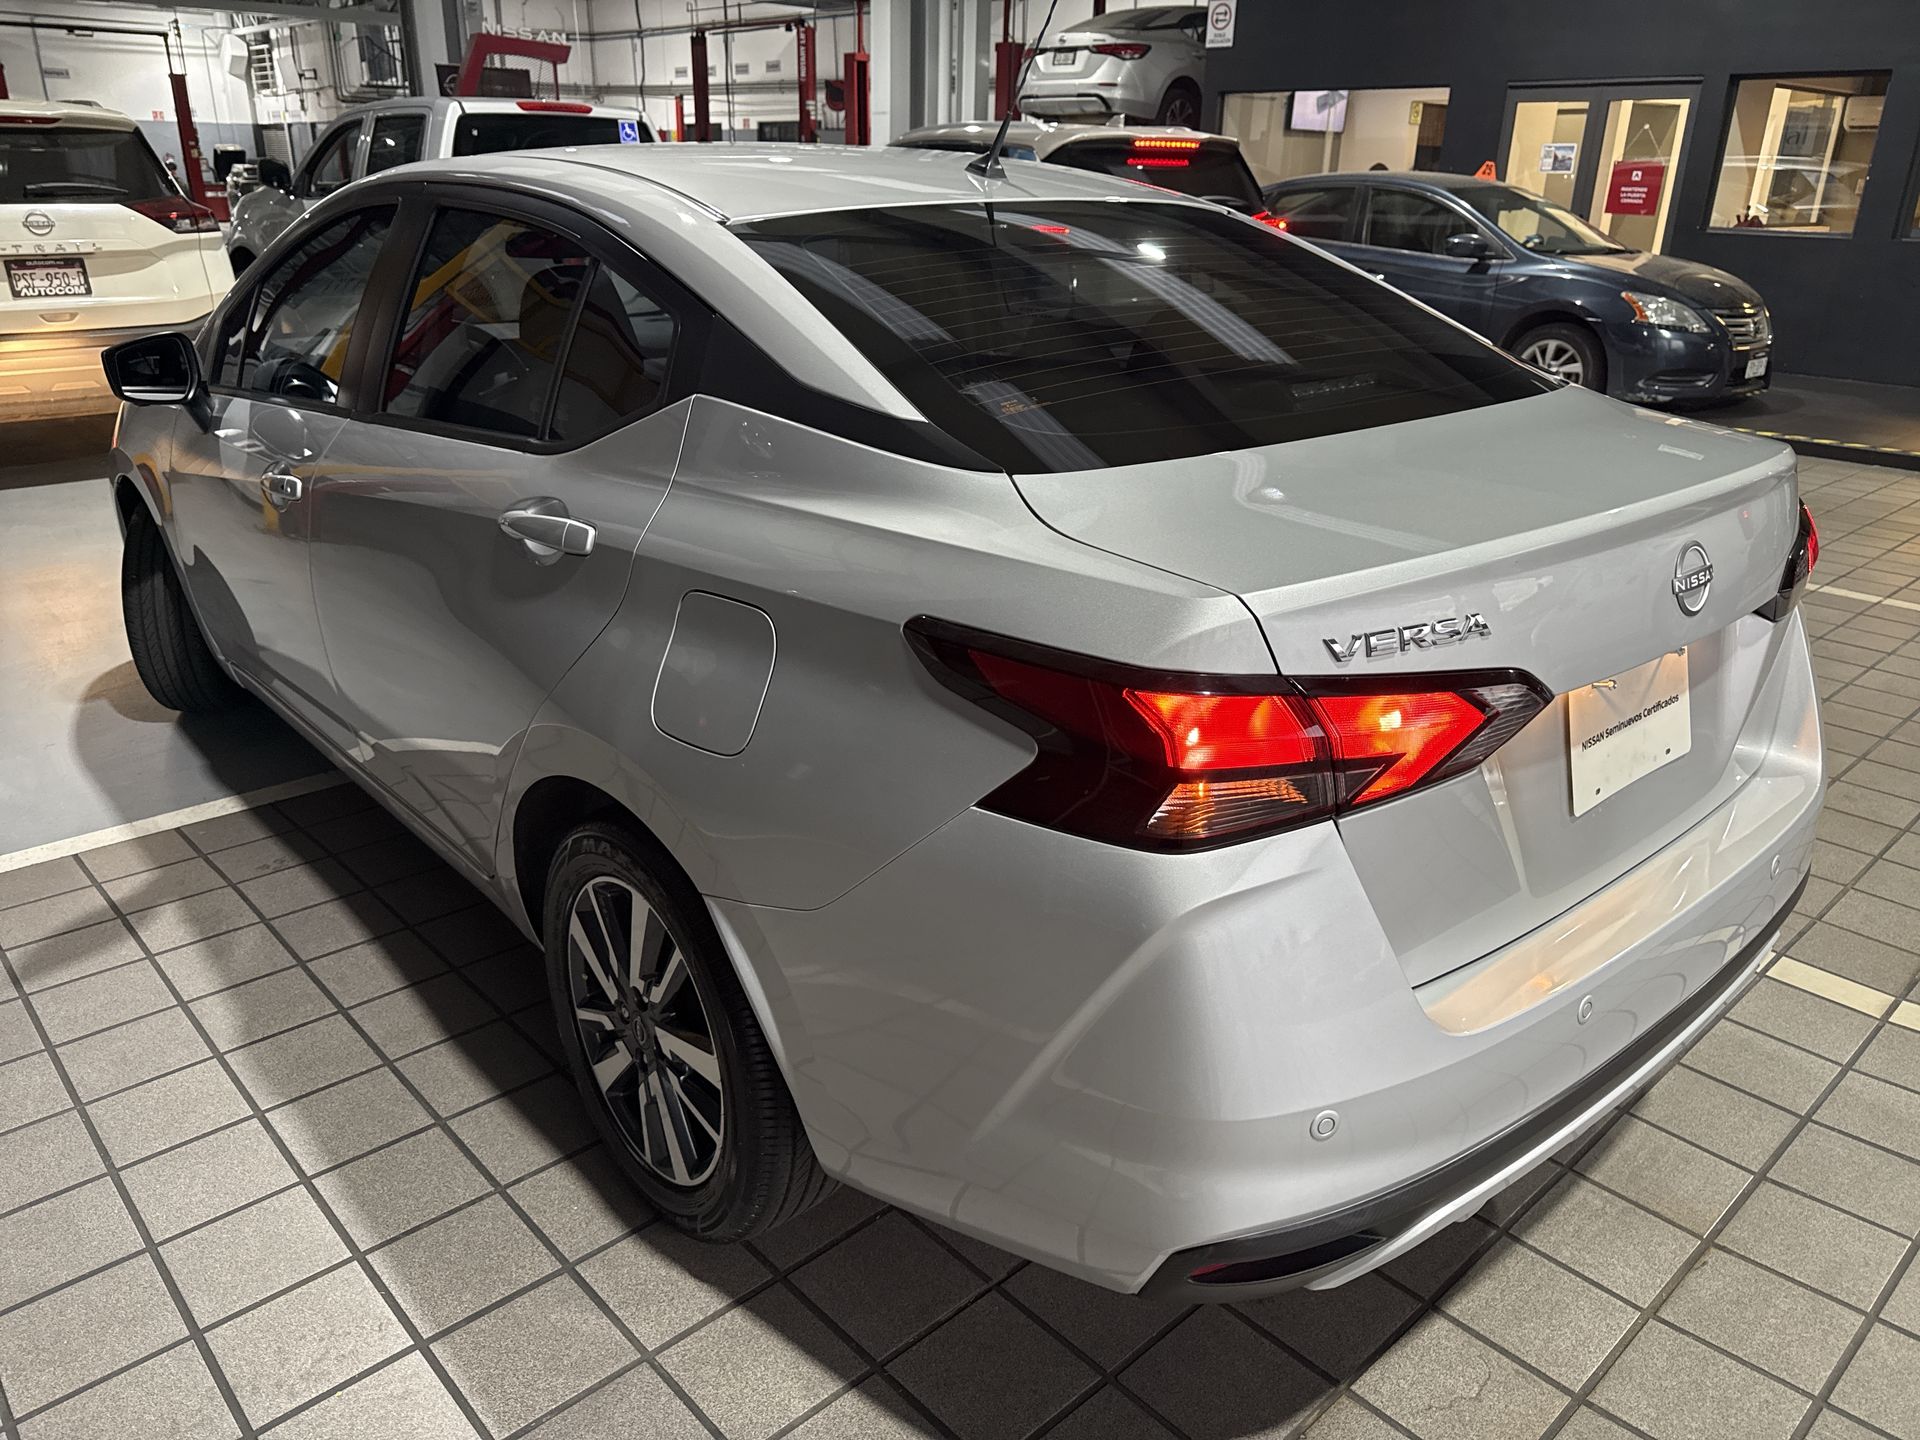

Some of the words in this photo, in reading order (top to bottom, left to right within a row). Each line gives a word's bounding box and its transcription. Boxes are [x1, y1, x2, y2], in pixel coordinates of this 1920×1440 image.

[481, 21, 567, 45] NISSAN
[20, 285, 87, 297] AUTOCOM
[1322, 612, 1492, 664] VERSA
[1580, 730, 1606, 753] NISSAN
[1605, 712, 1643, 739] Seminuevos
[1642, 693, 1680, 719] Certificados
